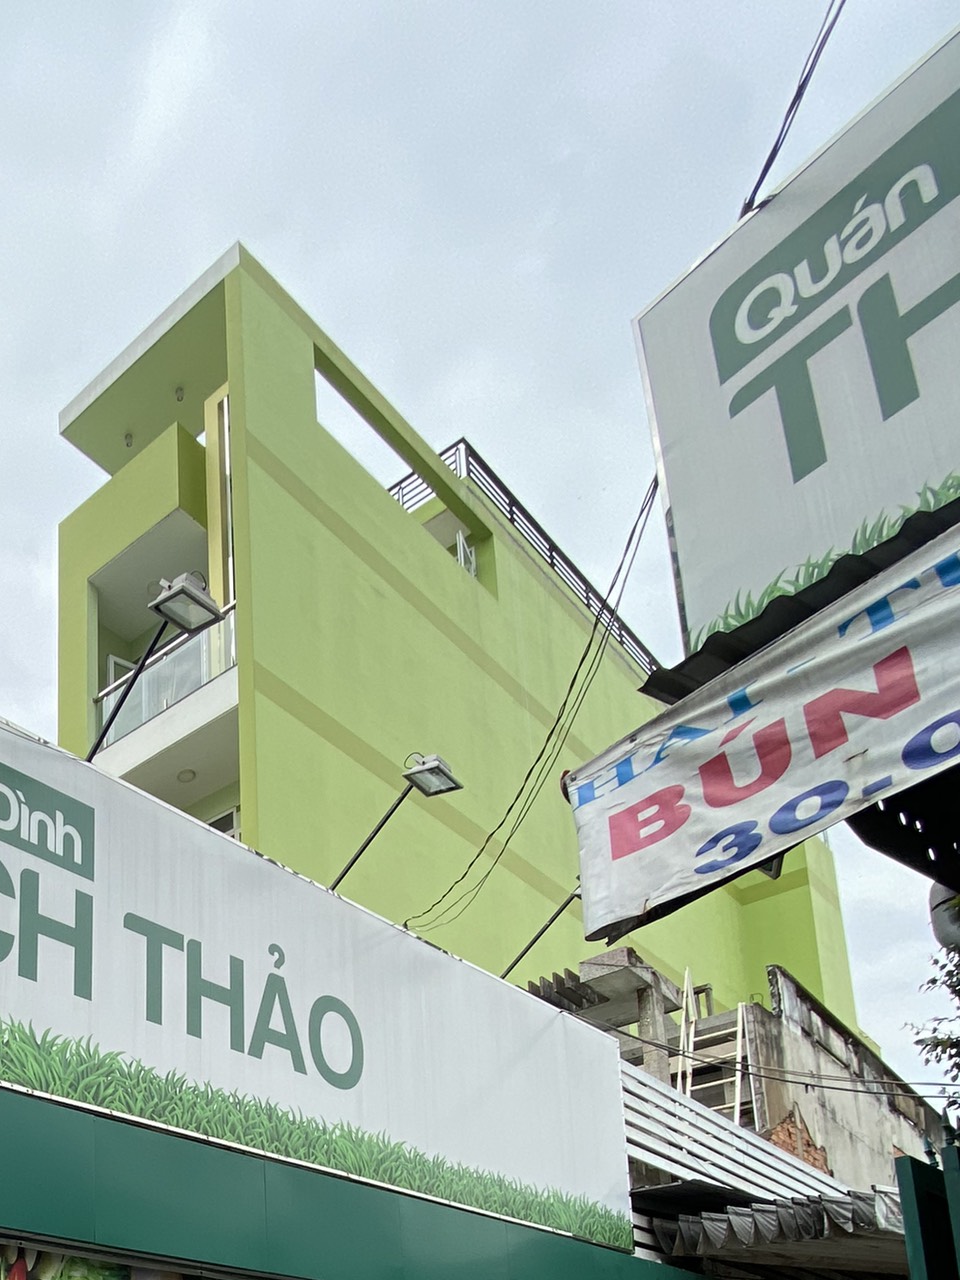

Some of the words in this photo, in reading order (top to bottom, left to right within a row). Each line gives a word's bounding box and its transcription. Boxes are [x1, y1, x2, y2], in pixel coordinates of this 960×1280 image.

[734, 163, 940, 344] Quán
[608, 645, 921, 861] BÚN
[123, 912, 364, 1091] THẢO
